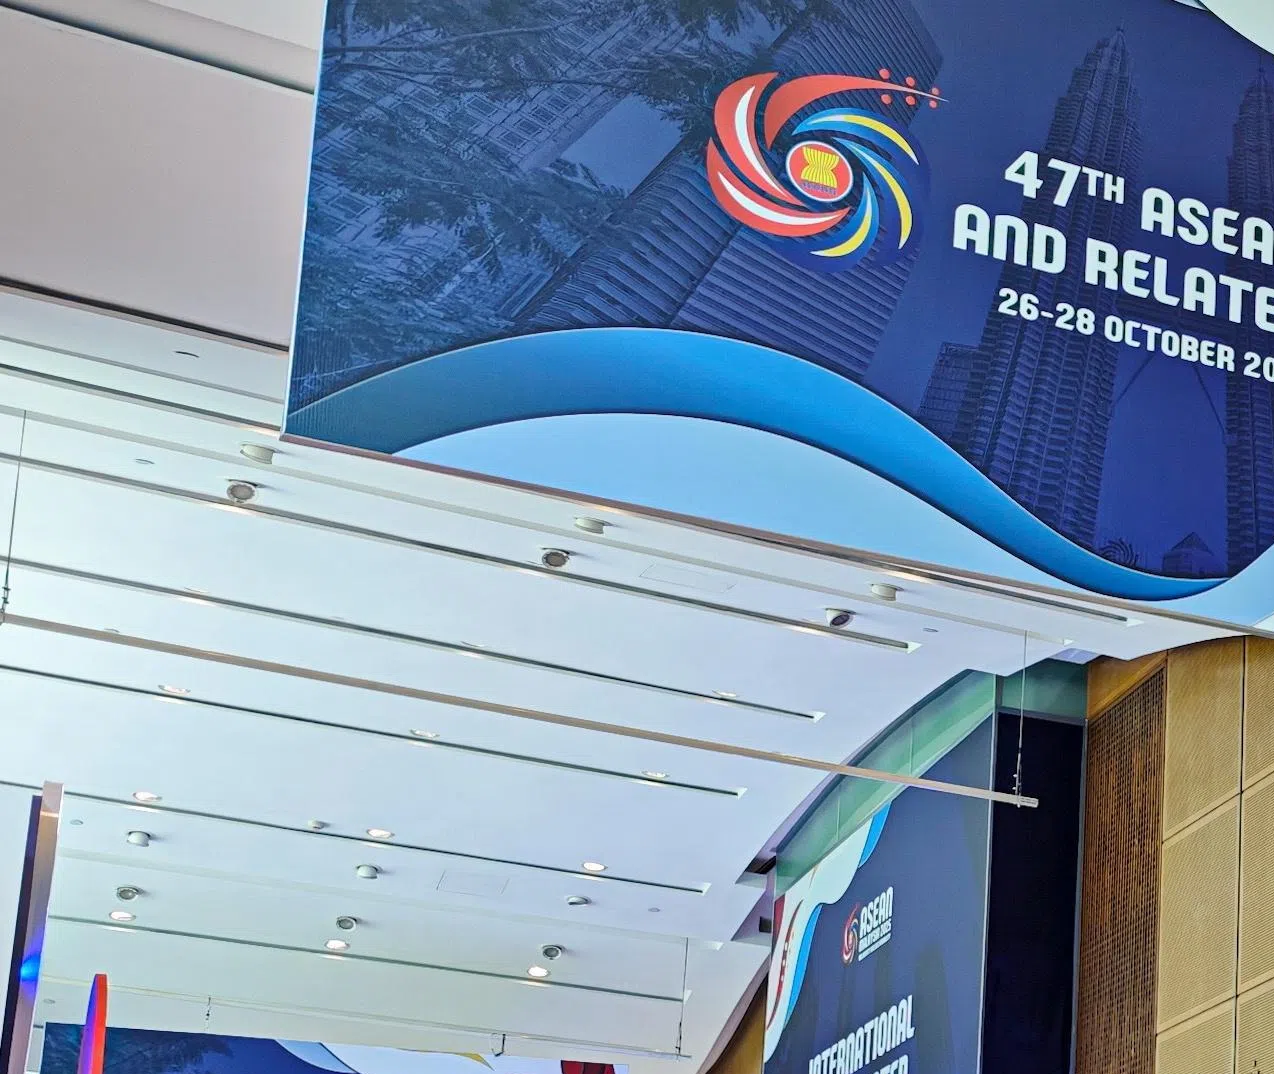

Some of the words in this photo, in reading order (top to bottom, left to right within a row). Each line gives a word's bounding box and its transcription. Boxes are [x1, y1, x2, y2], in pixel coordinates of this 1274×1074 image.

[1004, 150, 1125, 208] 47TH
[953, 203, 1067, 275] AND
[998, 287, 1096, 336] 26-28
[1104, 315, 1235, 372] OCTOBER
[860, 886, 894, 939] ASEAN
